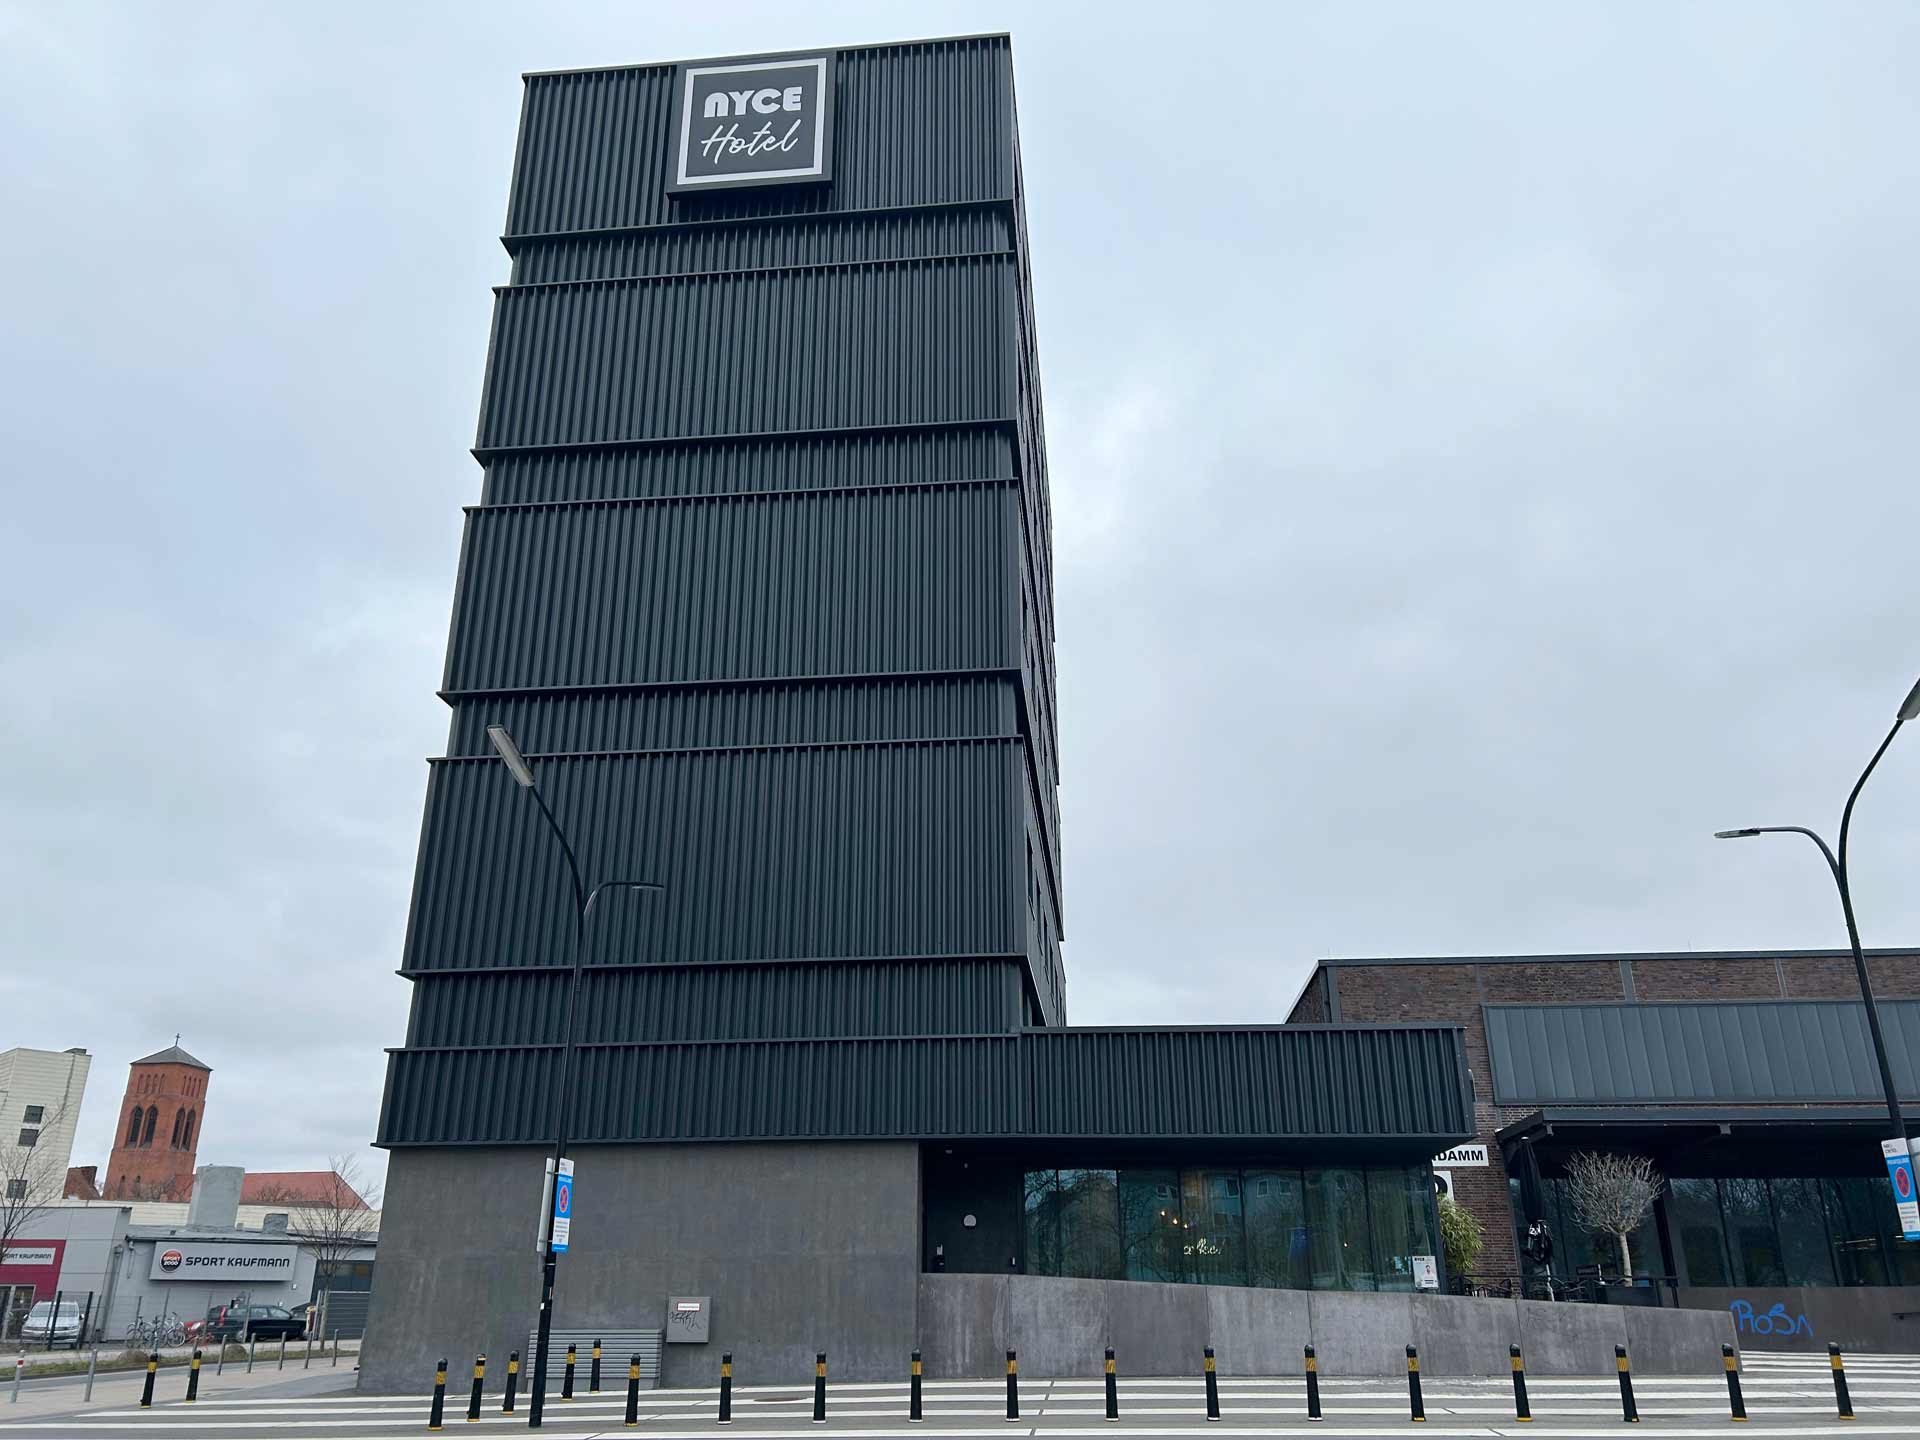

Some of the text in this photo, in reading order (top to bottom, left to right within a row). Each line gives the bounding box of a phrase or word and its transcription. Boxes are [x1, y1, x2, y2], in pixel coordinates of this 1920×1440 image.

[703, 86, 803, 118] NYCE
[700, 118, 802, 165] Hotel
[1432, 1150, 1484, 1161] DAMM
[185, 1256, 290, 1268] SPORT KAUFMANN
